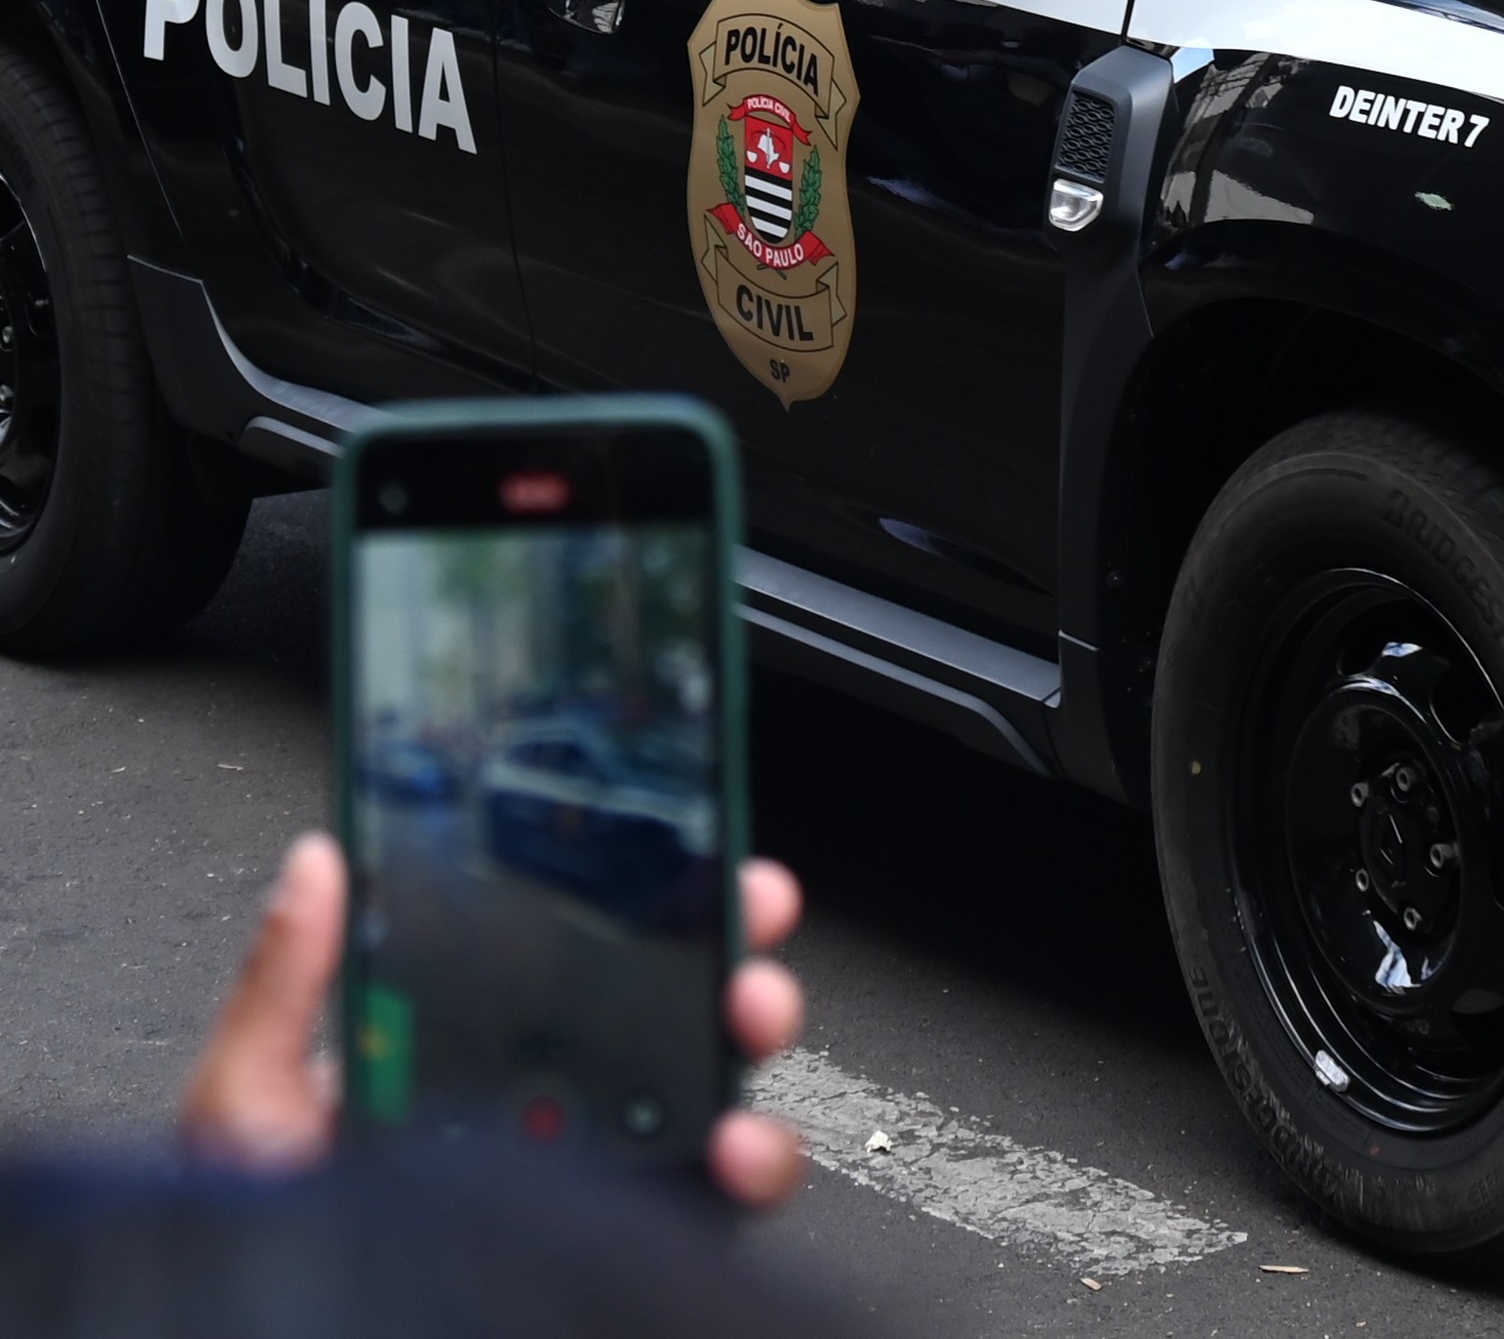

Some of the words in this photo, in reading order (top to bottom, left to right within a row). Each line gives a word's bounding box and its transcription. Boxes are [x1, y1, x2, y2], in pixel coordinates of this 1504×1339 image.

[724, 22, 819, 97] POLÍCIA
[1329, 85, 1465, 144] DEINTER
[1463, 114, 1490, 148] 7
[765, 244, 804, 268] PAULO
[735, 283, 814, 342] CIVIL
[769, 358, 790, 385] SP
